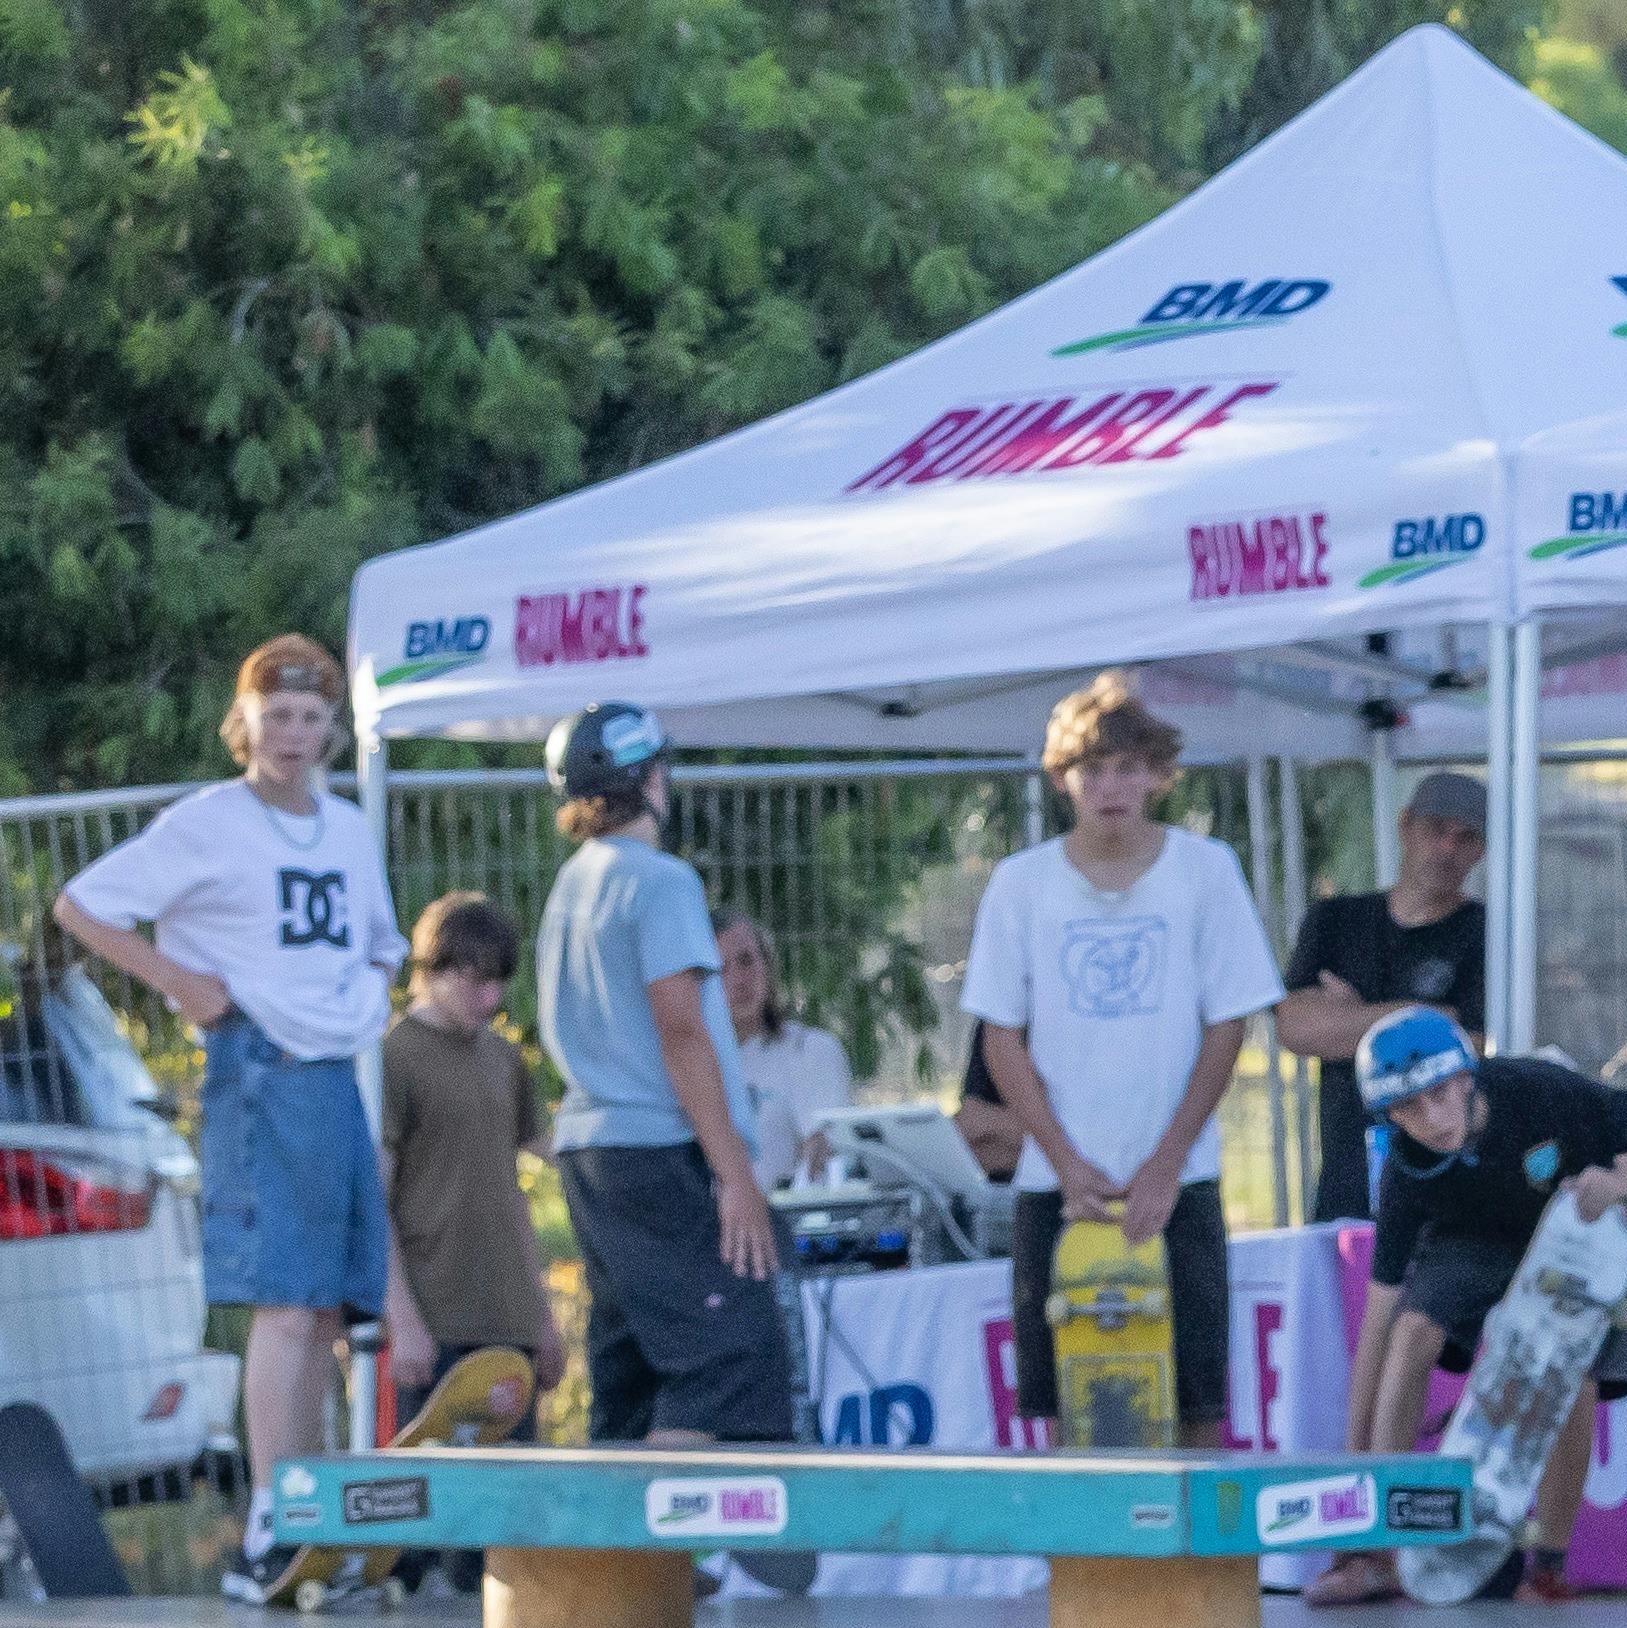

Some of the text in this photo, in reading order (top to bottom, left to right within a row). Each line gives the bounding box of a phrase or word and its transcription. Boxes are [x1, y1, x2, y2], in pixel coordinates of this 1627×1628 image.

[1139, 279, 1333, 325] BMD
[843, 381, 1281, 493] RUMBLE
[1189, 512, 1487, 602] RUMBLE BMD
[404, 584, 651, 668] BMD RUMBLE
